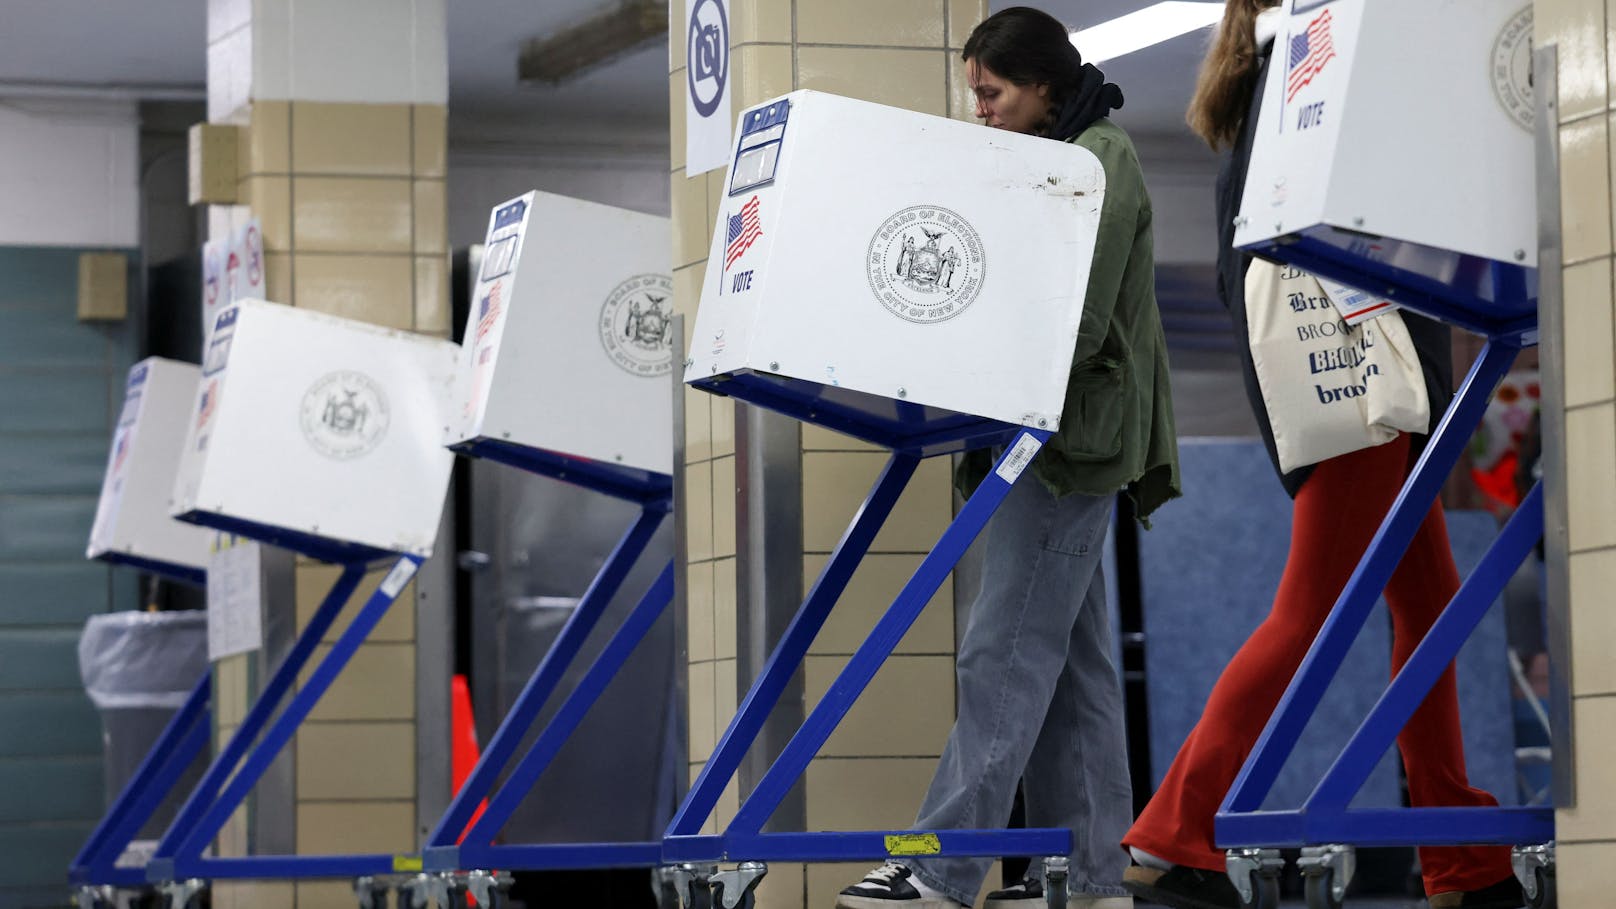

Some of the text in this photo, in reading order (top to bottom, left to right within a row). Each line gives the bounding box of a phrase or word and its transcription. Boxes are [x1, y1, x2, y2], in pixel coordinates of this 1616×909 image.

[1297, 101, 1325, 131] VOTE
[880, 210, 981, 264] BOARD OF ELECTIONS
[872, 252, 881, 265] IN
[732, 269, 754, 294] VOTE
[873, 267, 886, 291] THE
[954, 276, 978, 305] YORK
[883, 291, 909, 313] CITY
[909, 307, 925, 318] OF
[928, 302, 954, 318] NEW
[1287, 291, 1330, 313] Bro
